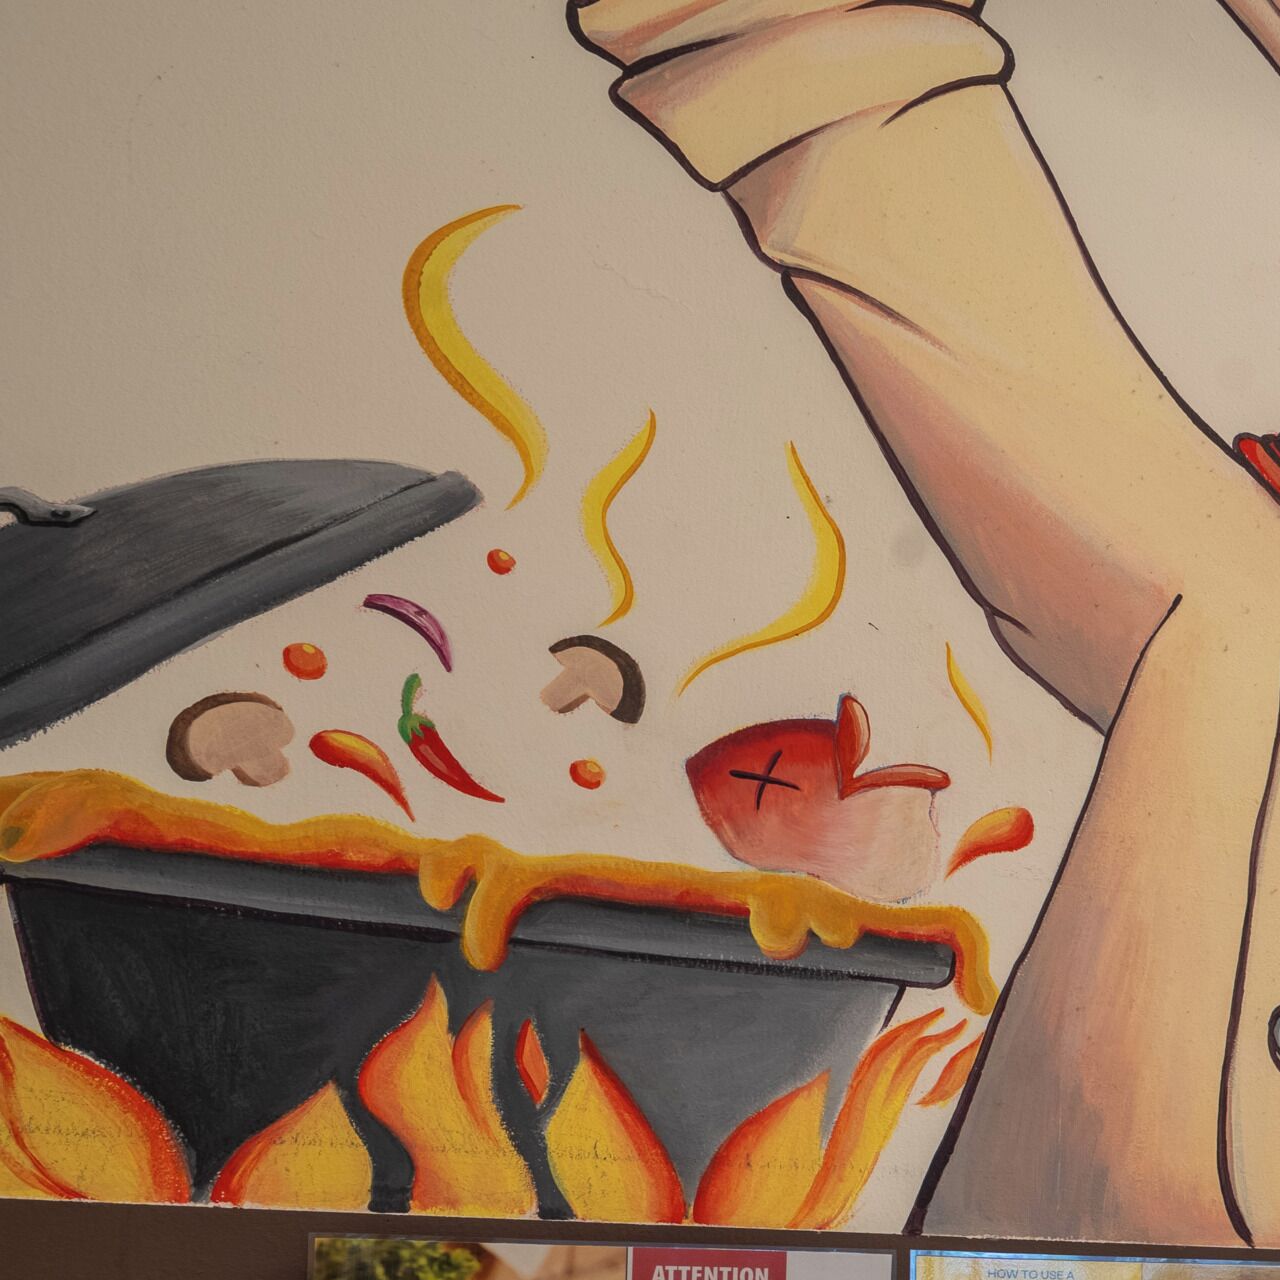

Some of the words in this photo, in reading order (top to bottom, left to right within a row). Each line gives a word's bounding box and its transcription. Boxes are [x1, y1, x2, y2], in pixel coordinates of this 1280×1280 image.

[987, 1268, 1019, 1279] HOW
[1020, 1269, 1038, 1280] TO
[1040, 1270, 1064, 1280] USE
[1066, 1271, 1075, 1280] A
